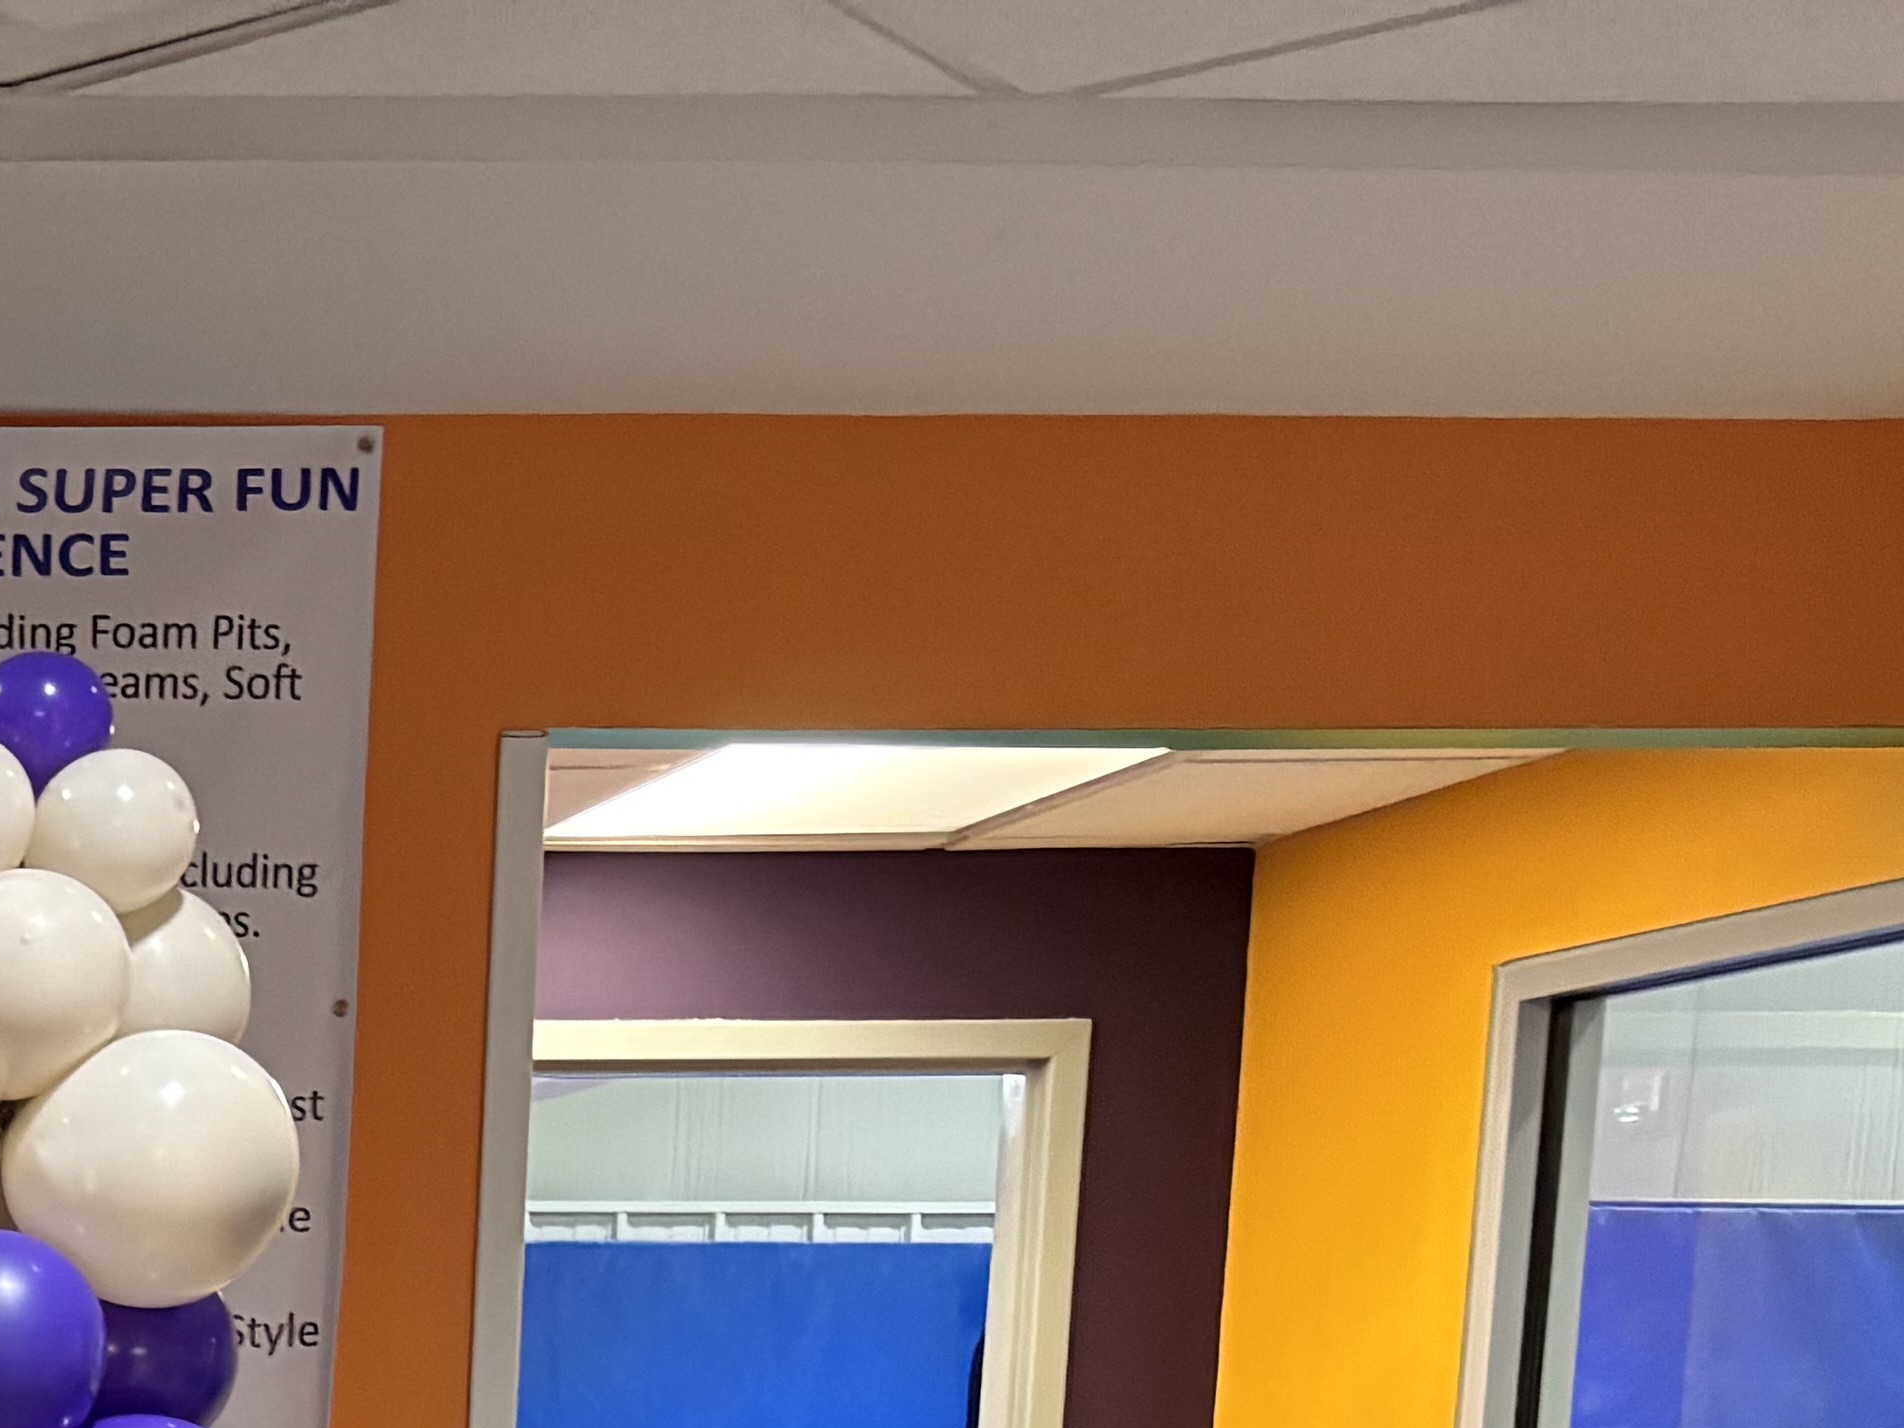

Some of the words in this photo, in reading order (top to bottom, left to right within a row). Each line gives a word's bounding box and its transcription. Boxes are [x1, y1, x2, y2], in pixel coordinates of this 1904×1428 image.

[16, 467, 214, 514] SUPER
[236, 466, 360, 512] FUN
[91, 614, 197, 650] Foam
[212, 614, 291, 657] Pits,
[100, 665, 212, 706] eams,
[223, 662, 303, 701] Soft
[181, 851, 319, 899] cluding
